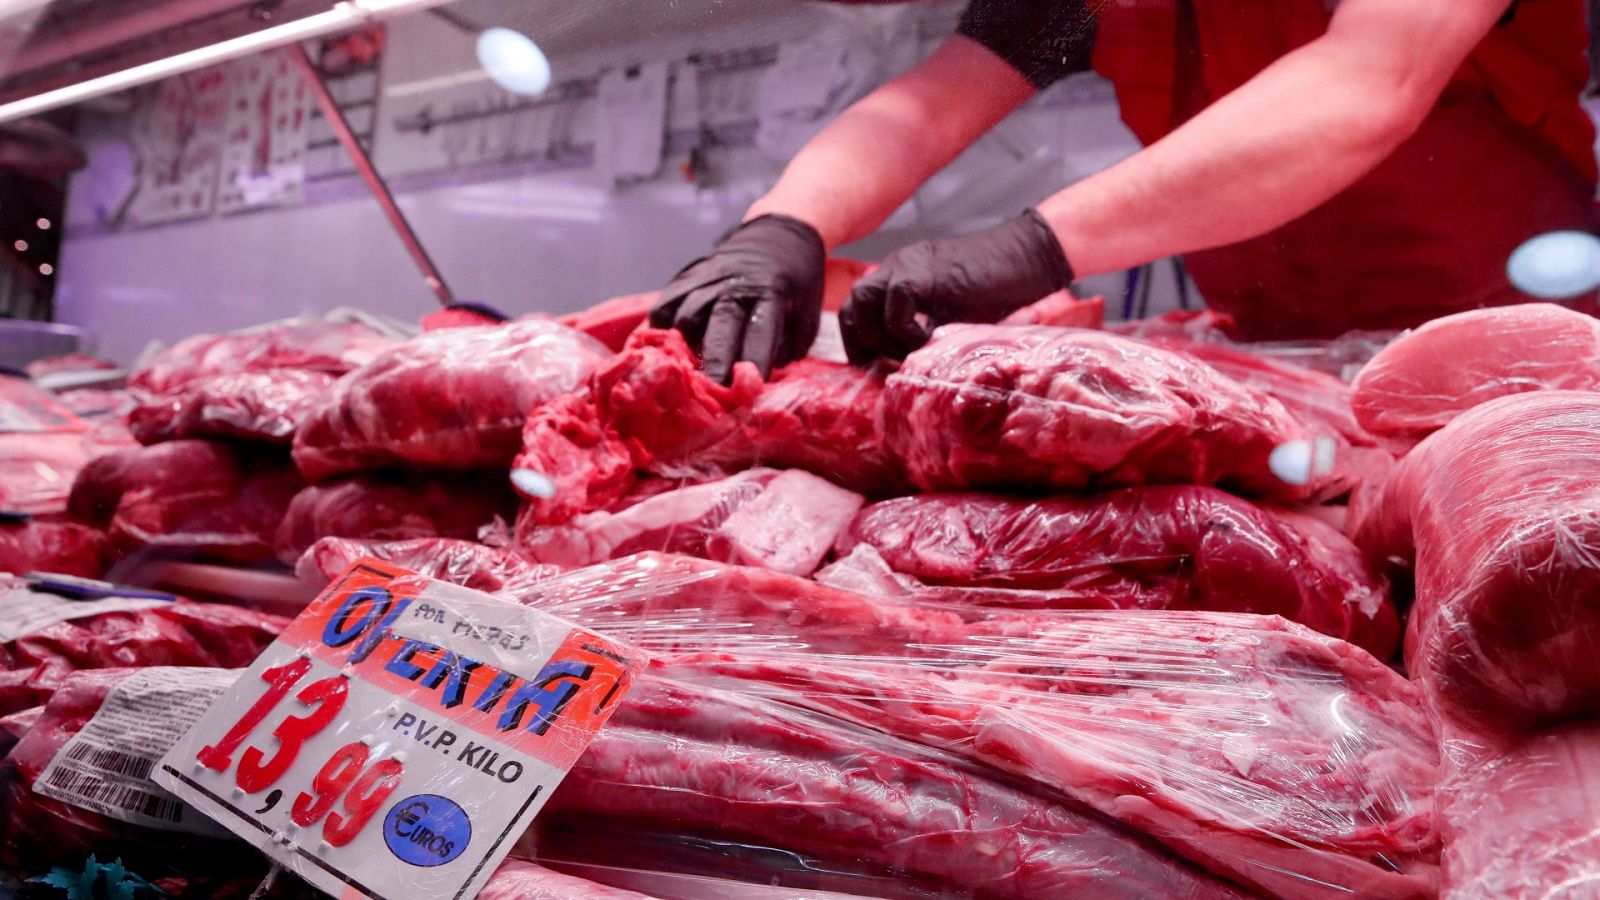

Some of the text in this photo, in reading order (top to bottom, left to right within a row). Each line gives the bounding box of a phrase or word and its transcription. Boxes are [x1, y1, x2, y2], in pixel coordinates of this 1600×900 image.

[196, 655, 405, 847] 13,99
[392, 711, 524, 783] P.V.P. KILO
